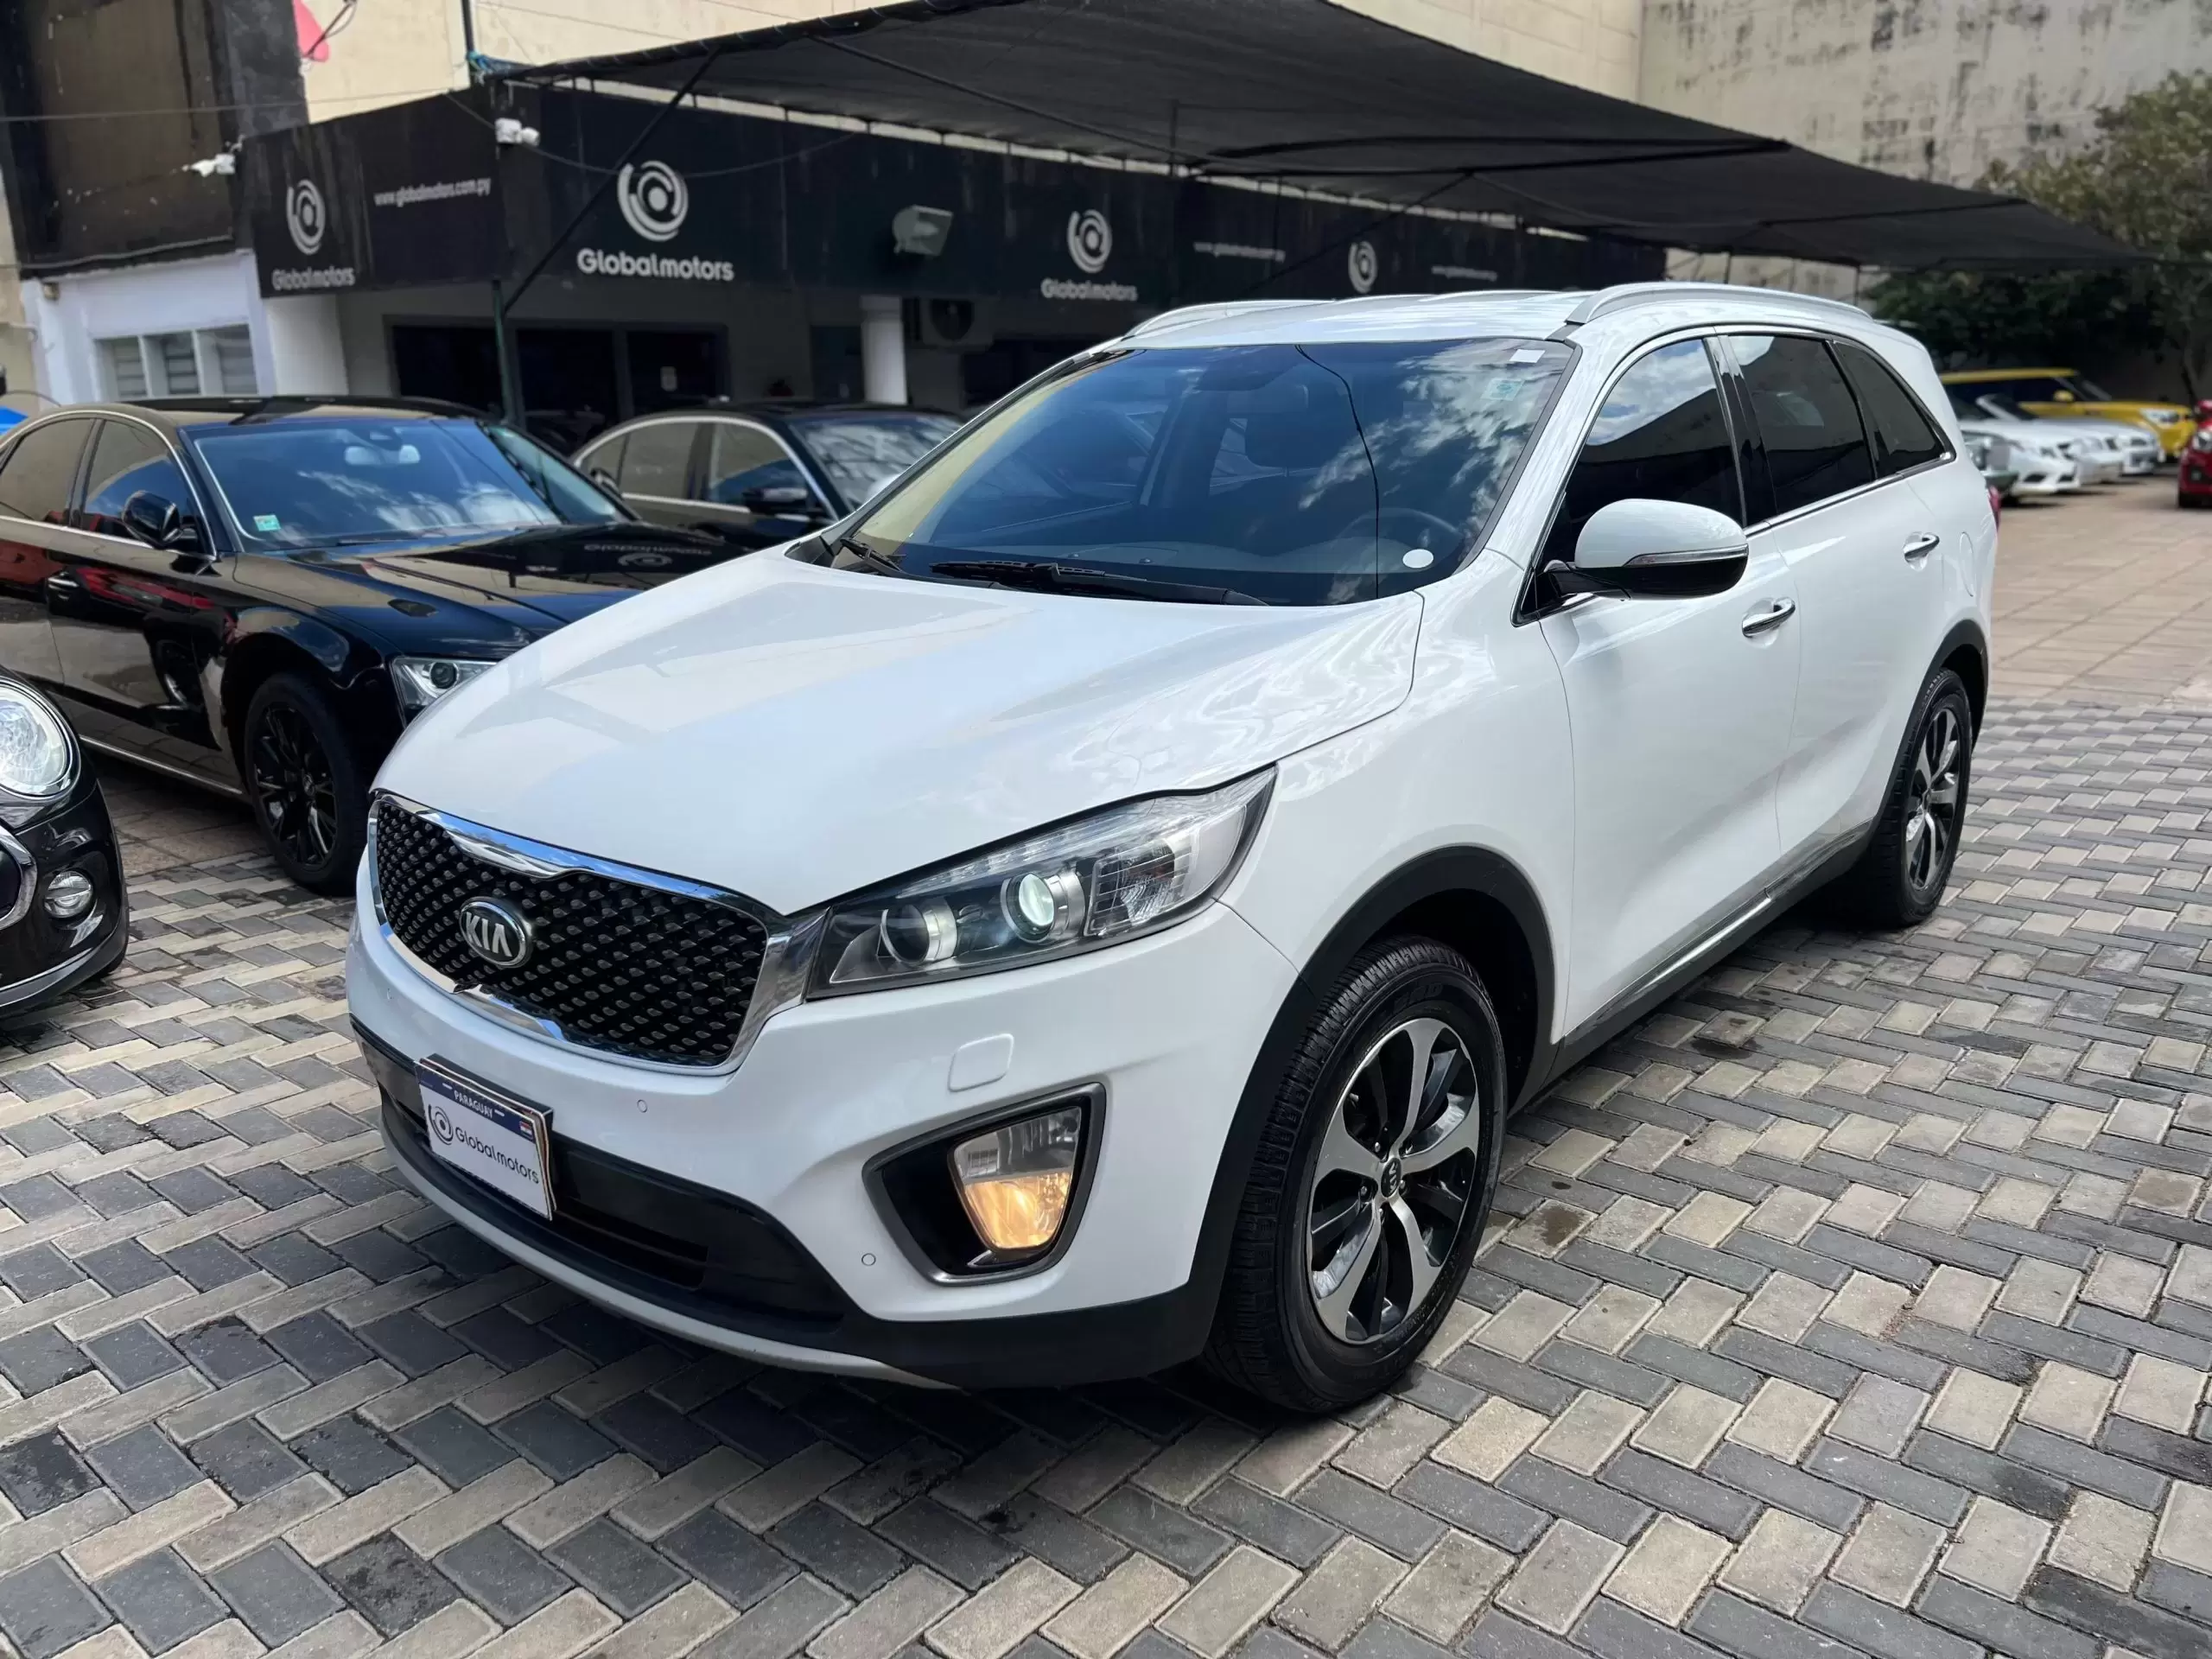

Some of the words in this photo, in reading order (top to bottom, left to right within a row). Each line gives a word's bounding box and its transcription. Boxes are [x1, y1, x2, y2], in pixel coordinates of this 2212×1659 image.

[272, 265, 355, 291] Globalmotors
[577, 248, 734, 282] Globalmotors
[1040, 277, 1138, 302] Globalmotors
[466, 912, 512, 957] KIA
[454, 1090, 493, 1118] PARAGUAY
[455, 1126, 539, 1185] Globalmotors
